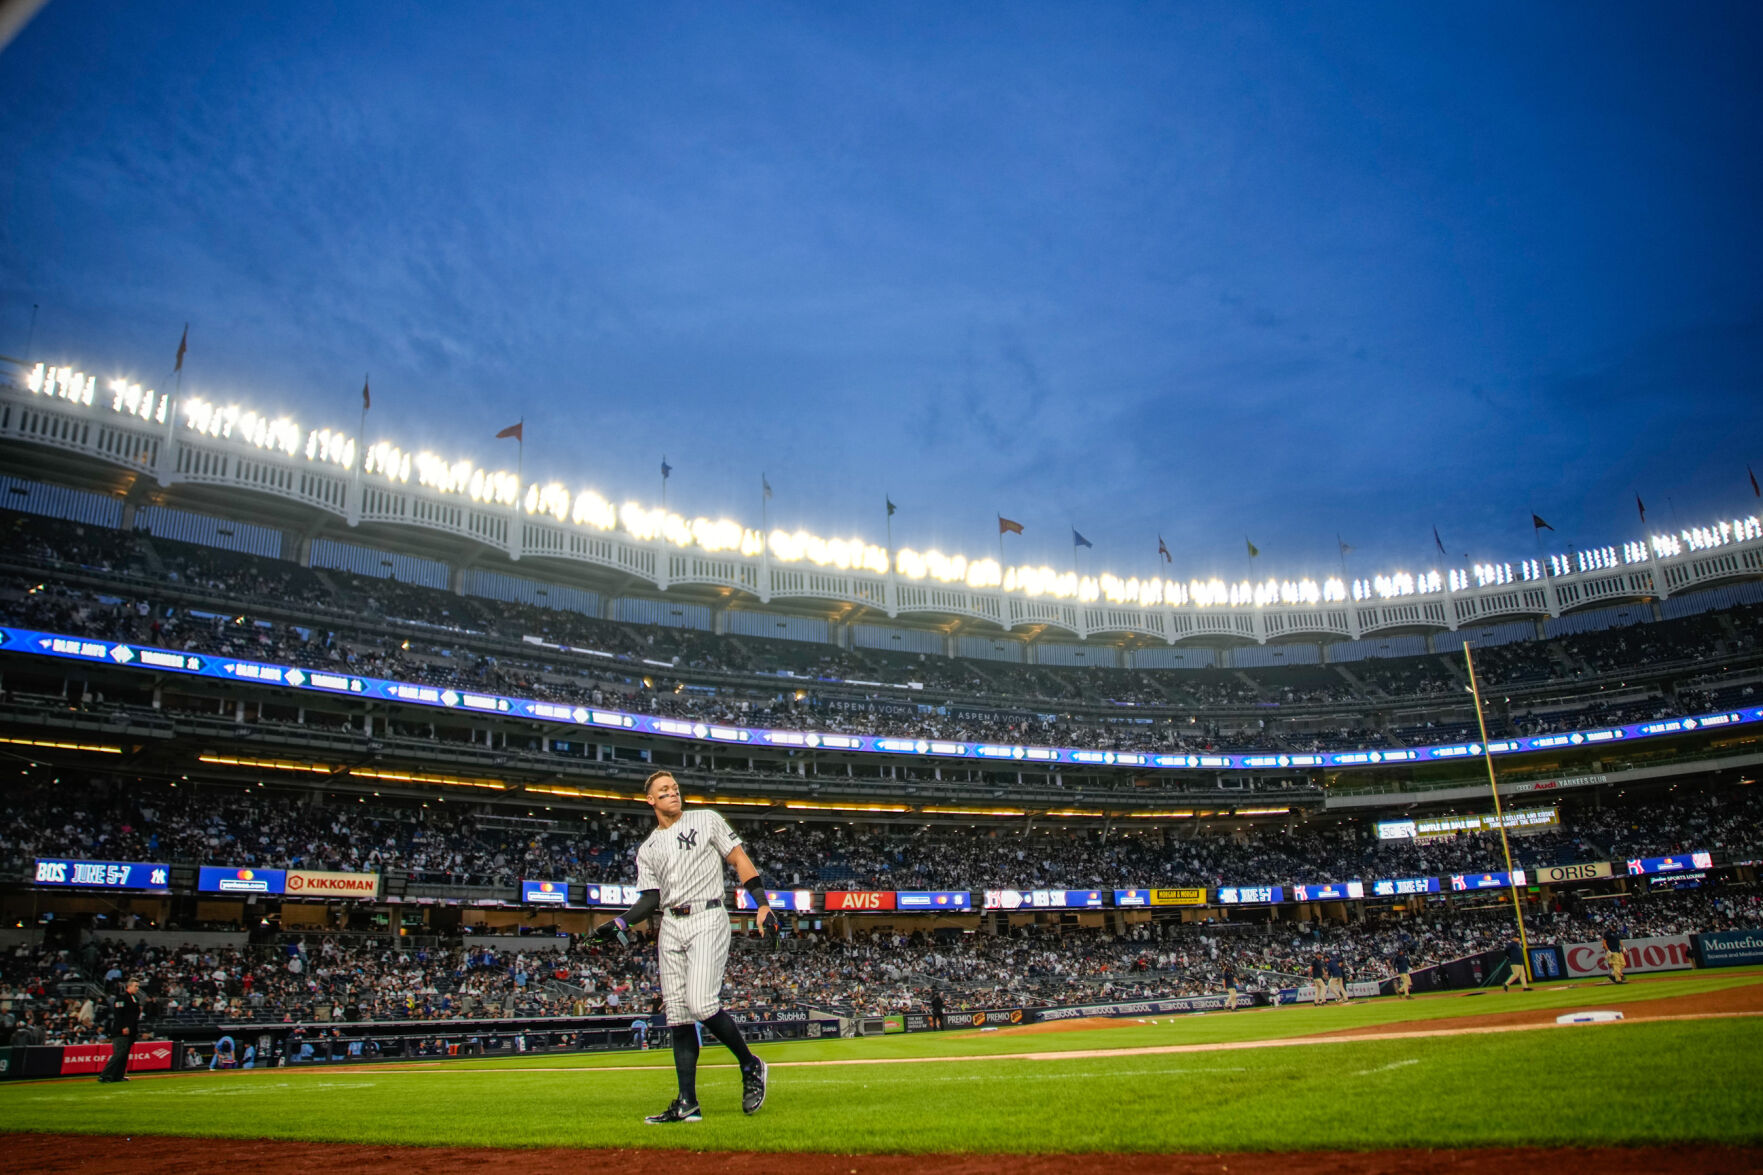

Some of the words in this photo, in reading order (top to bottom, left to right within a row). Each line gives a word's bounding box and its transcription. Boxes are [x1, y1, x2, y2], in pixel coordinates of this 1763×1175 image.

[829, 702, 865, 710] ASPEN
[958, 712, 990, 720] ASPEN
[1535, 781, 1556, 790] Audi
[1559, 777, 1588, 787] YANKEES
[1590, 775, 1607, 784] CLUB
[35, 862, 67, 882] BOS
[71, 863, 106, 884] JUNE
[106, 865, 131, 885] 5-7
[1550, 865, 1597, 881] ORIS
[307, 878, 373, 890] KIKKOMAN
[842, 893, 879, 908] AVIS
[1060, 1009, 1080, 1018] COOL
[1096, 1007, 1116, 1016] COOL
[1133, 1004, 1151, 1014] COOL
[777, 1012, 806, 1021] StubHub
[947, 1014, 972, 1024] PREMIO
[986, 1012, 1010, 1022] PREMIO
[64, 1055, 91, 1063] BANK
